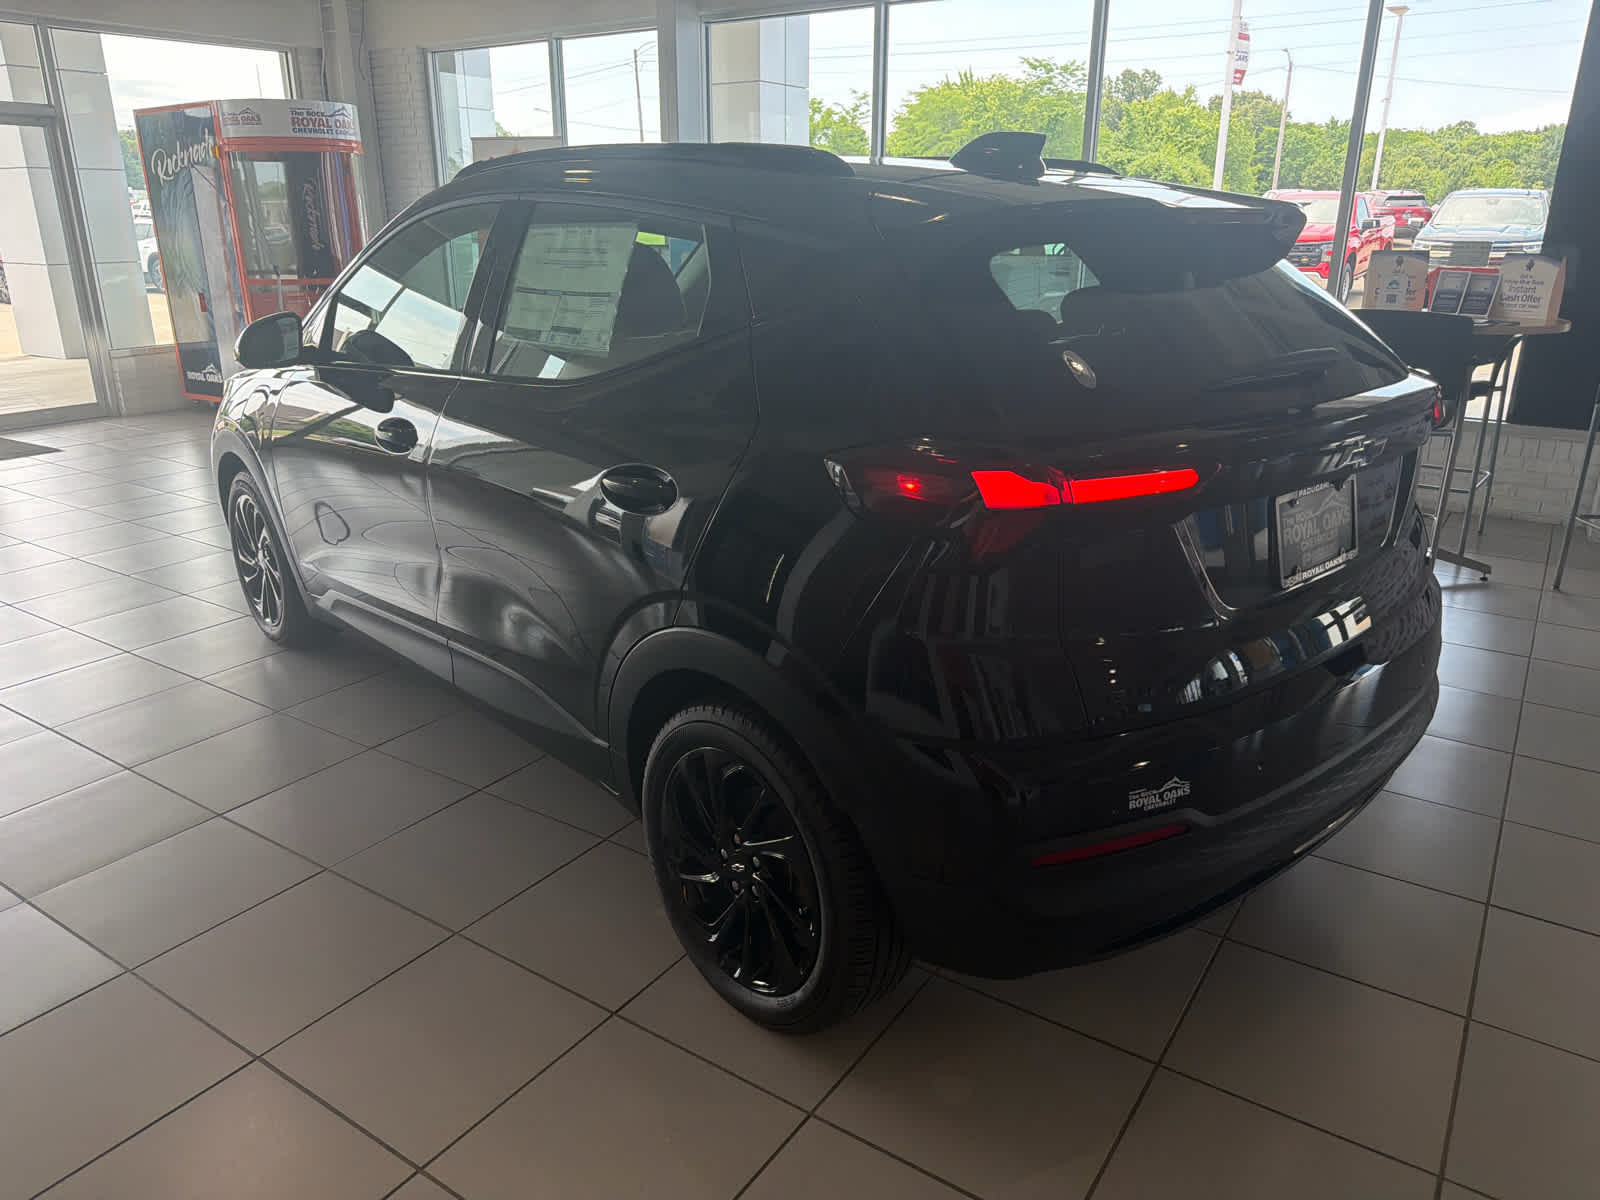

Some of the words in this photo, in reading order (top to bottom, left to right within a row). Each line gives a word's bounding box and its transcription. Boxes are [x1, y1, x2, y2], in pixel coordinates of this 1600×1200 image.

[290, 116, 332, 129] ROYAL
[1283, 518, 1321, 548] ROYAL
[1303, 566, 1324, 579] ROYAL
[1129, 794, 1160, 809] ROYAL
[1163, 785, 1190, 800] OAKS
